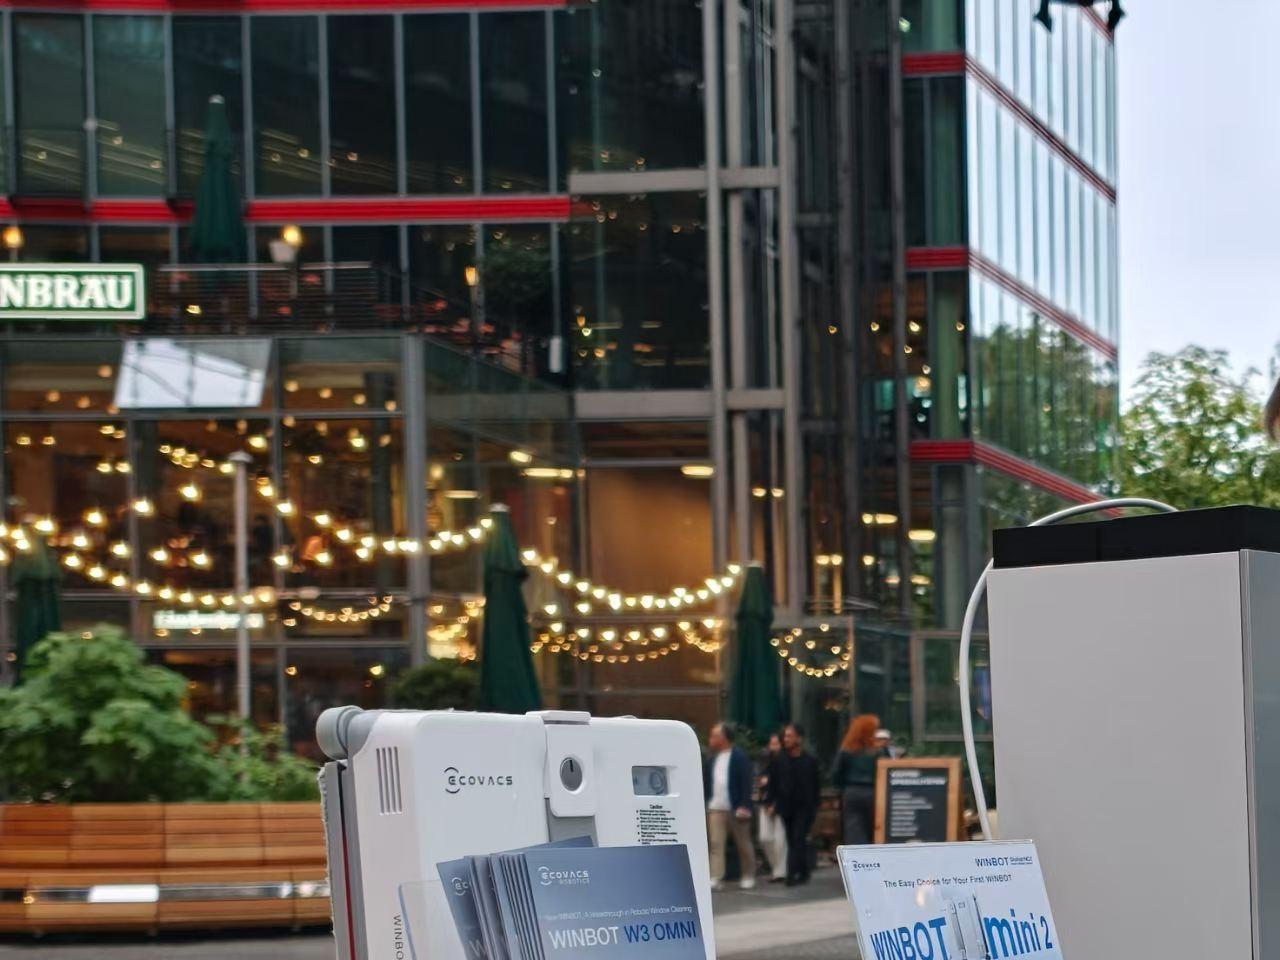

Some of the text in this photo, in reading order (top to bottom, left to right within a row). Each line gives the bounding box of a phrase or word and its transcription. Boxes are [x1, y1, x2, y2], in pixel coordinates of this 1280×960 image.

[975, 857, 1008, 867] WINBOT
[884, 880, 897, 888] The
[898, 880, 915, 888] Easy
[917, 878, 940, 886] Choice
[942, 877, 951, 885] for
[970, 875, 984, 883] First
[986, 874, 1012, 882] WINBOT
[549, 921, 697, 949] WINBOT W3 OMNI
[984, 908, 1041, 960] mini
[1040, 916, 1053, 949] 2
